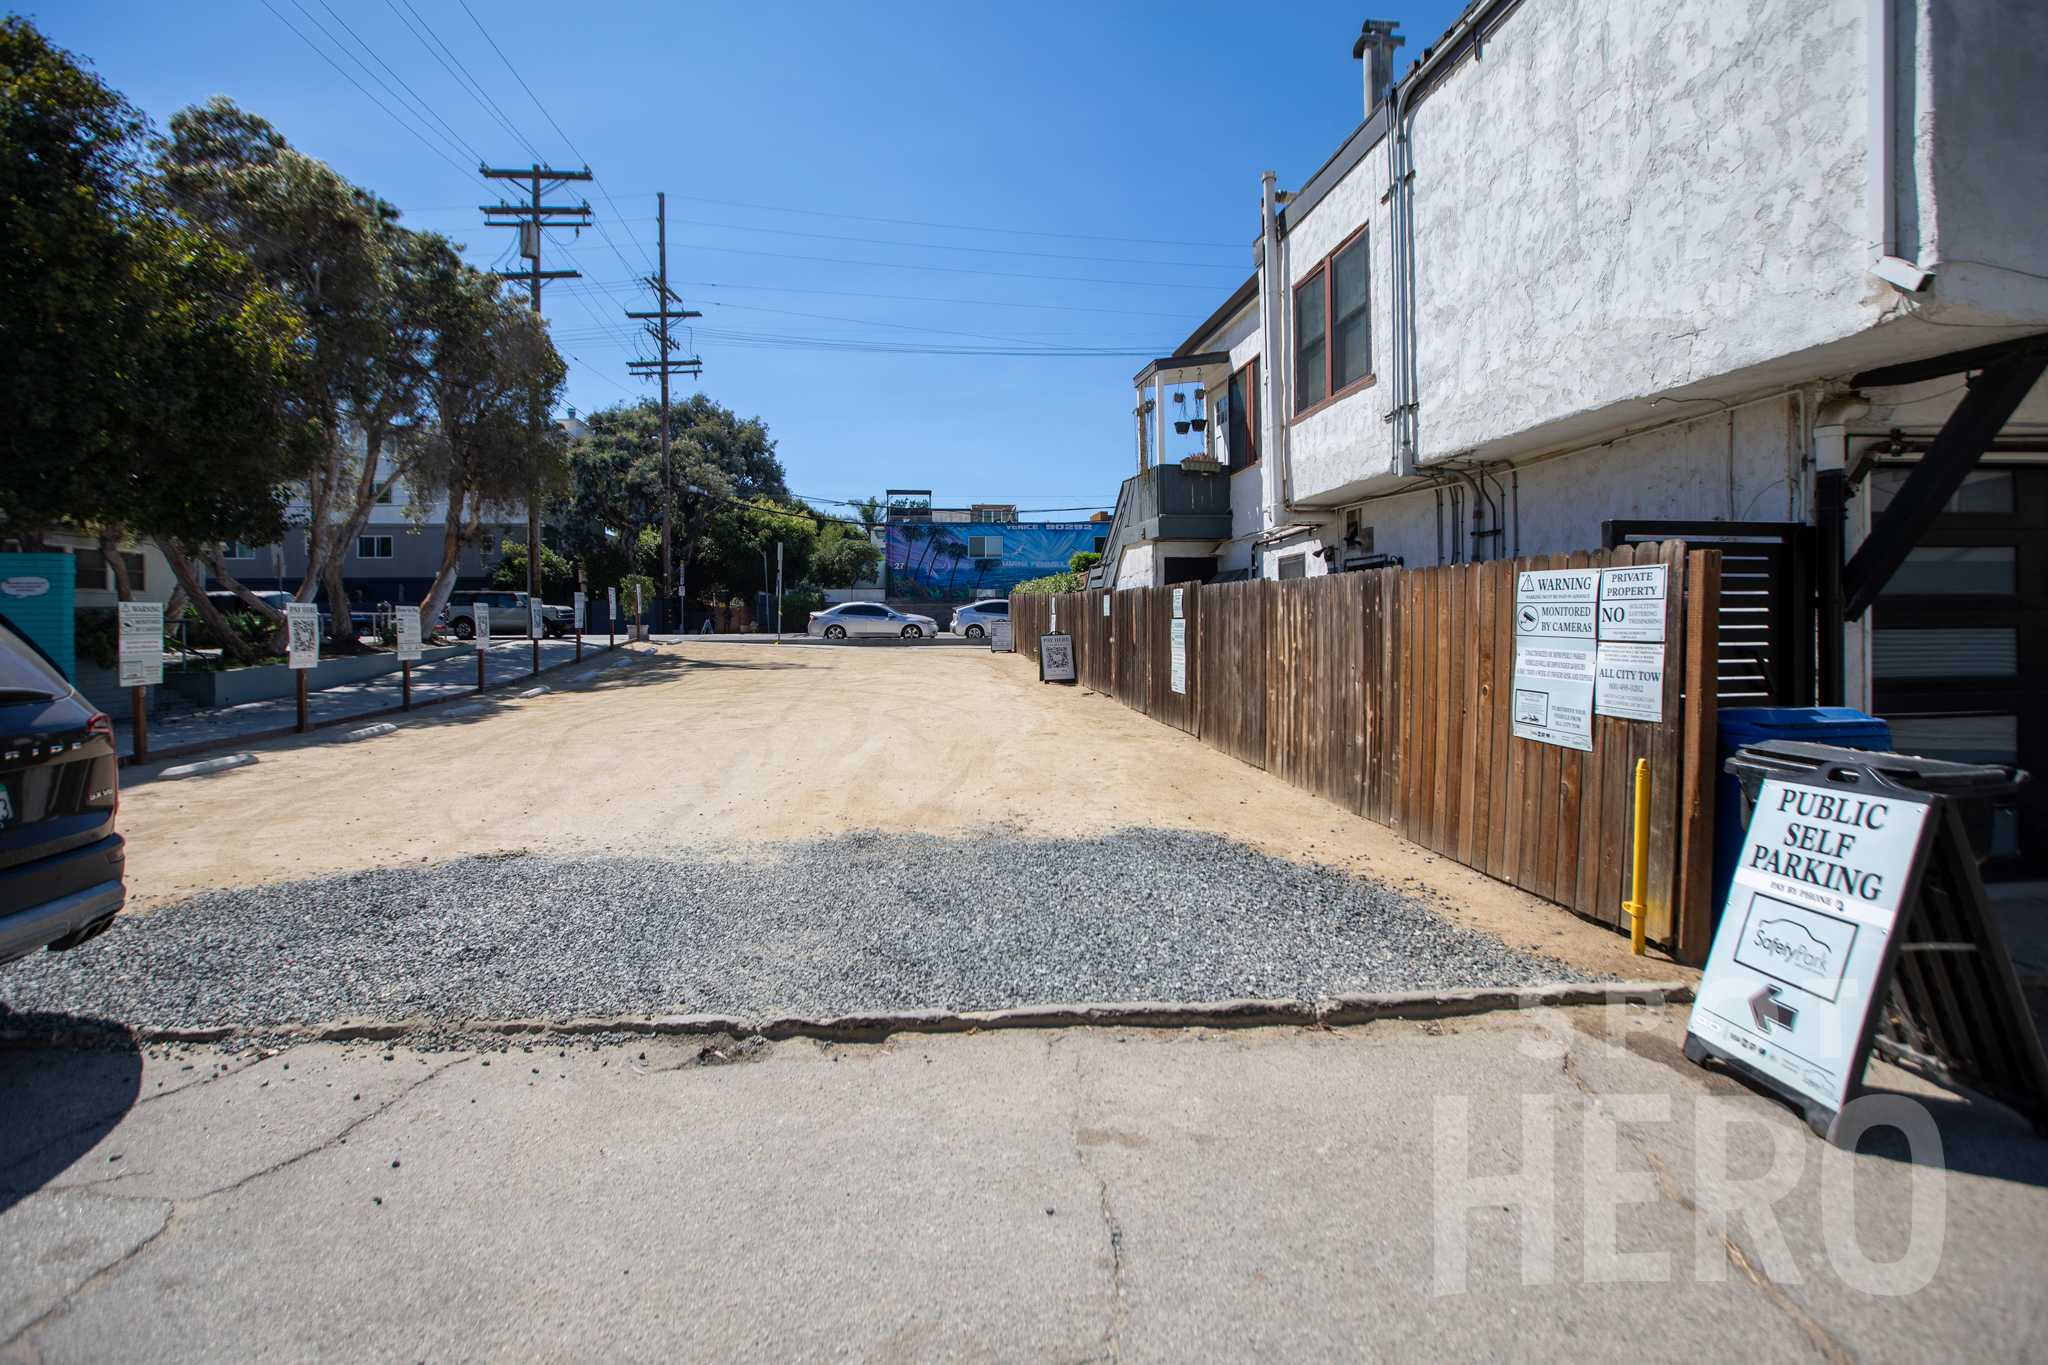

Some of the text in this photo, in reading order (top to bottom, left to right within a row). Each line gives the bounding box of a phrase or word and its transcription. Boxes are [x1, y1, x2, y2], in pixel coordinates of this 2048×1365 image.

[1537, 576, 1592, 591] WARNING
[1612, 571, 1653, 583] PRIVATE
[1607, 586, 1657, 597] PROPERTY
[1541, 606, 1591, 617] MONITORED
[1602, 606, 1625, 623] NO
[1541, 622, 1592, 633] BY CAMERAS
[1600, 668, 1615, 679] ALL
[1616, 669, 1636, 680] CITY
[1639, 671, 1661, 682] TOW
[1777, 788, 1888, 830] PUBLIC
[1784, 822, 1856, 859] SELF
[1750, 844, 1882, 901] PARKING
[1770, 881, 1832, 907] PAY BY PHONE
